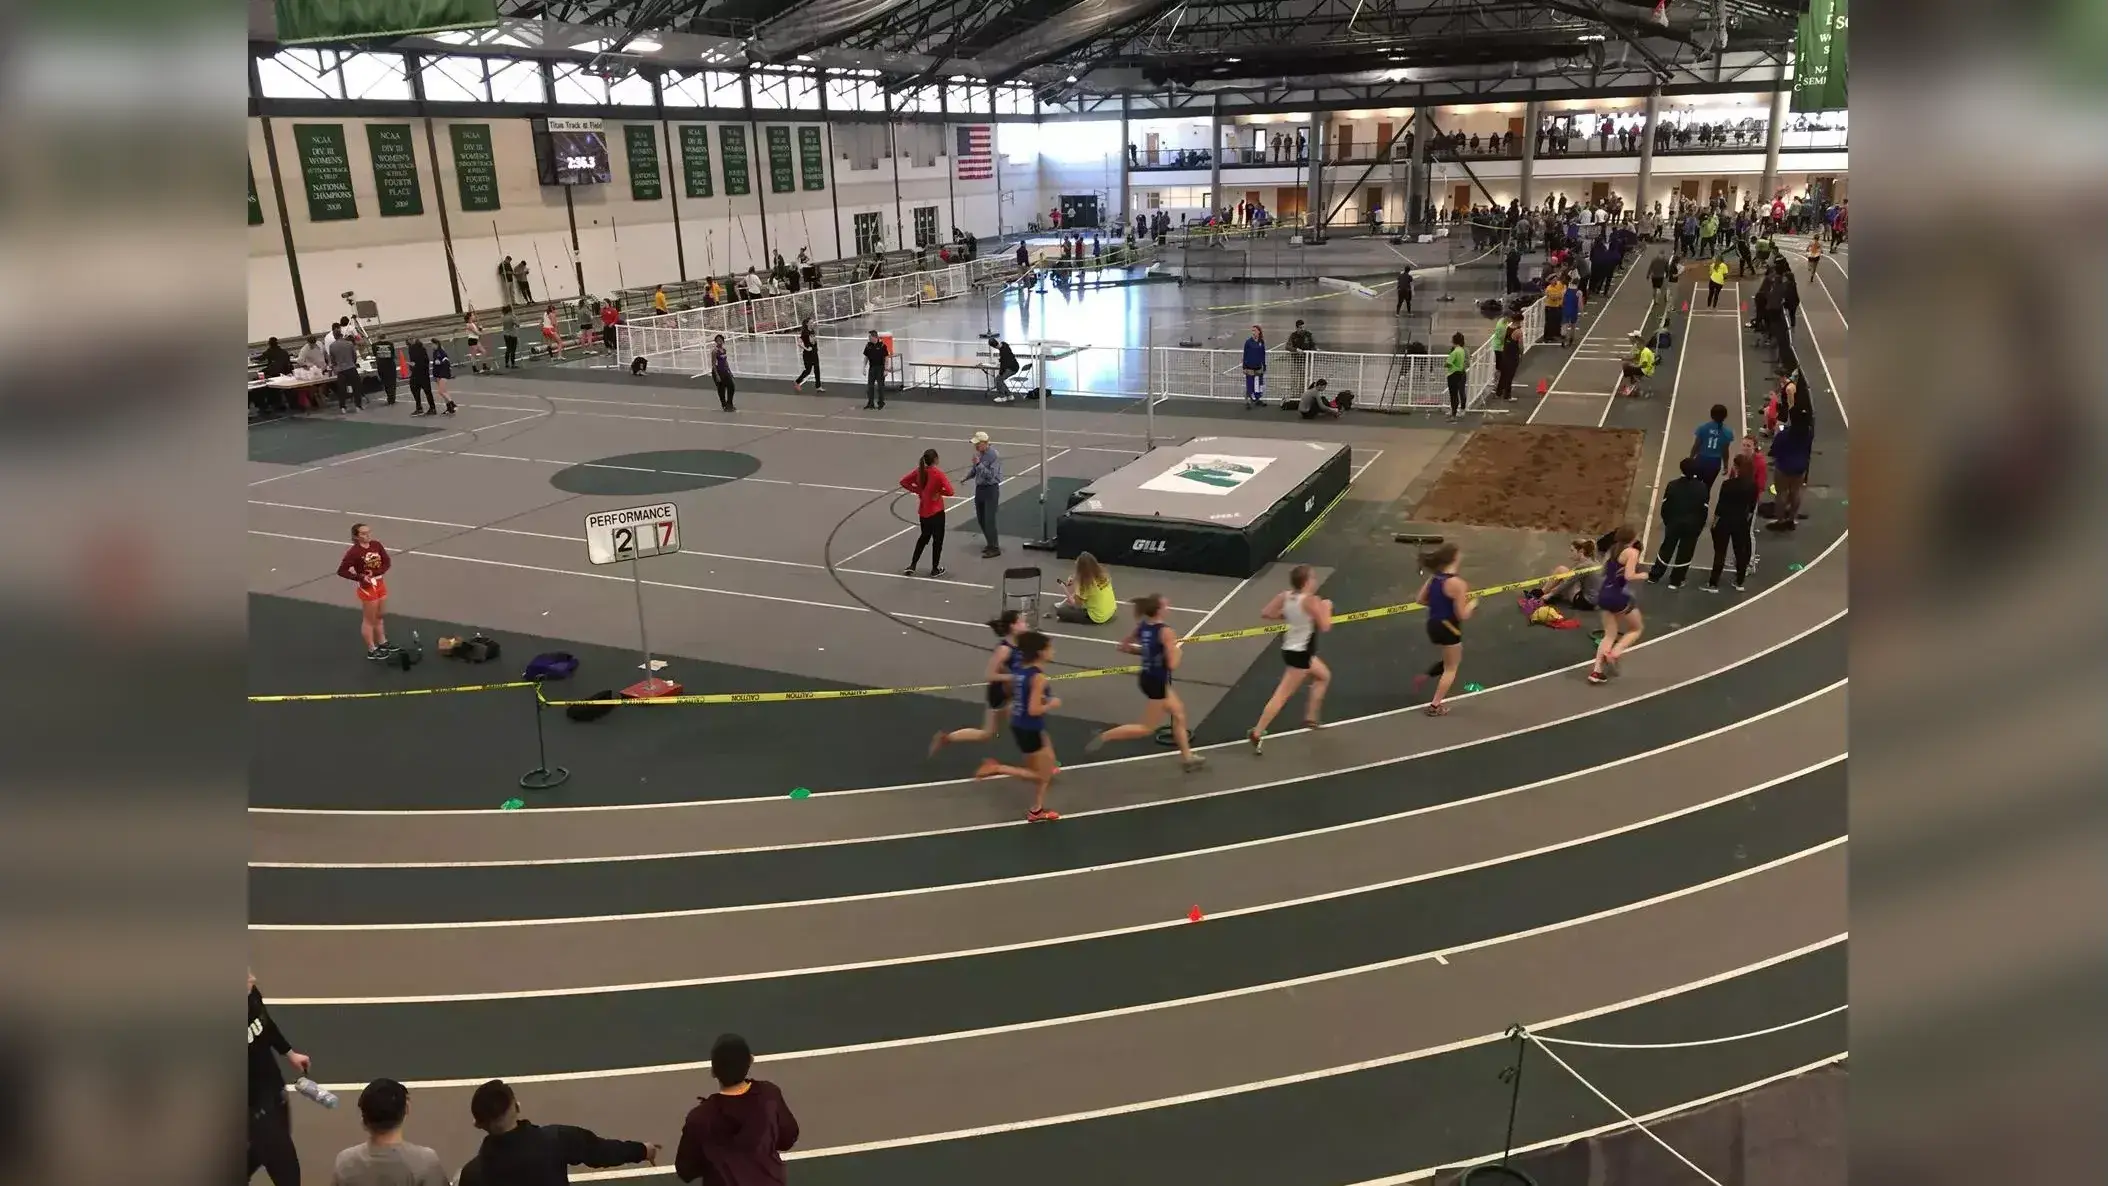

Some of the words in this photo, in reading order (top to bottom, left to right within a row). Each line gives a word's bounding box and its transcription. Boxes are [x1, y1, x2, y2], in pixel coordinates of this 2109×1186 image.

[566, 121, 581, 129] Track
[311, 136, 333, 144] NCAA
[379, 131, 401, 140] NCAA
[308, 156, 343, 165] WOMEN'S
[377, 154, 410, 162] WOMEN'S
[460, 153, 490, 161] WOMEN'S
[312, 183, 349, 191] NATIONAL
[384, 178, 412, 187] FOURTH
[389, 188, 411, 196] PLACE
[470, 184, 490, 192] PLACE
[312, 191, 352, 200] CHAMPIONS
[589, 506, 672, 528] PERFORMANCE
[615, 528, 634, 553] 2
[658, 522, 674, 548] 7
[1132, 539, 1167, 552] GILL
[730, 694, 761, 703] CAUTION
[785, 691, 815, 700] CAUTION
